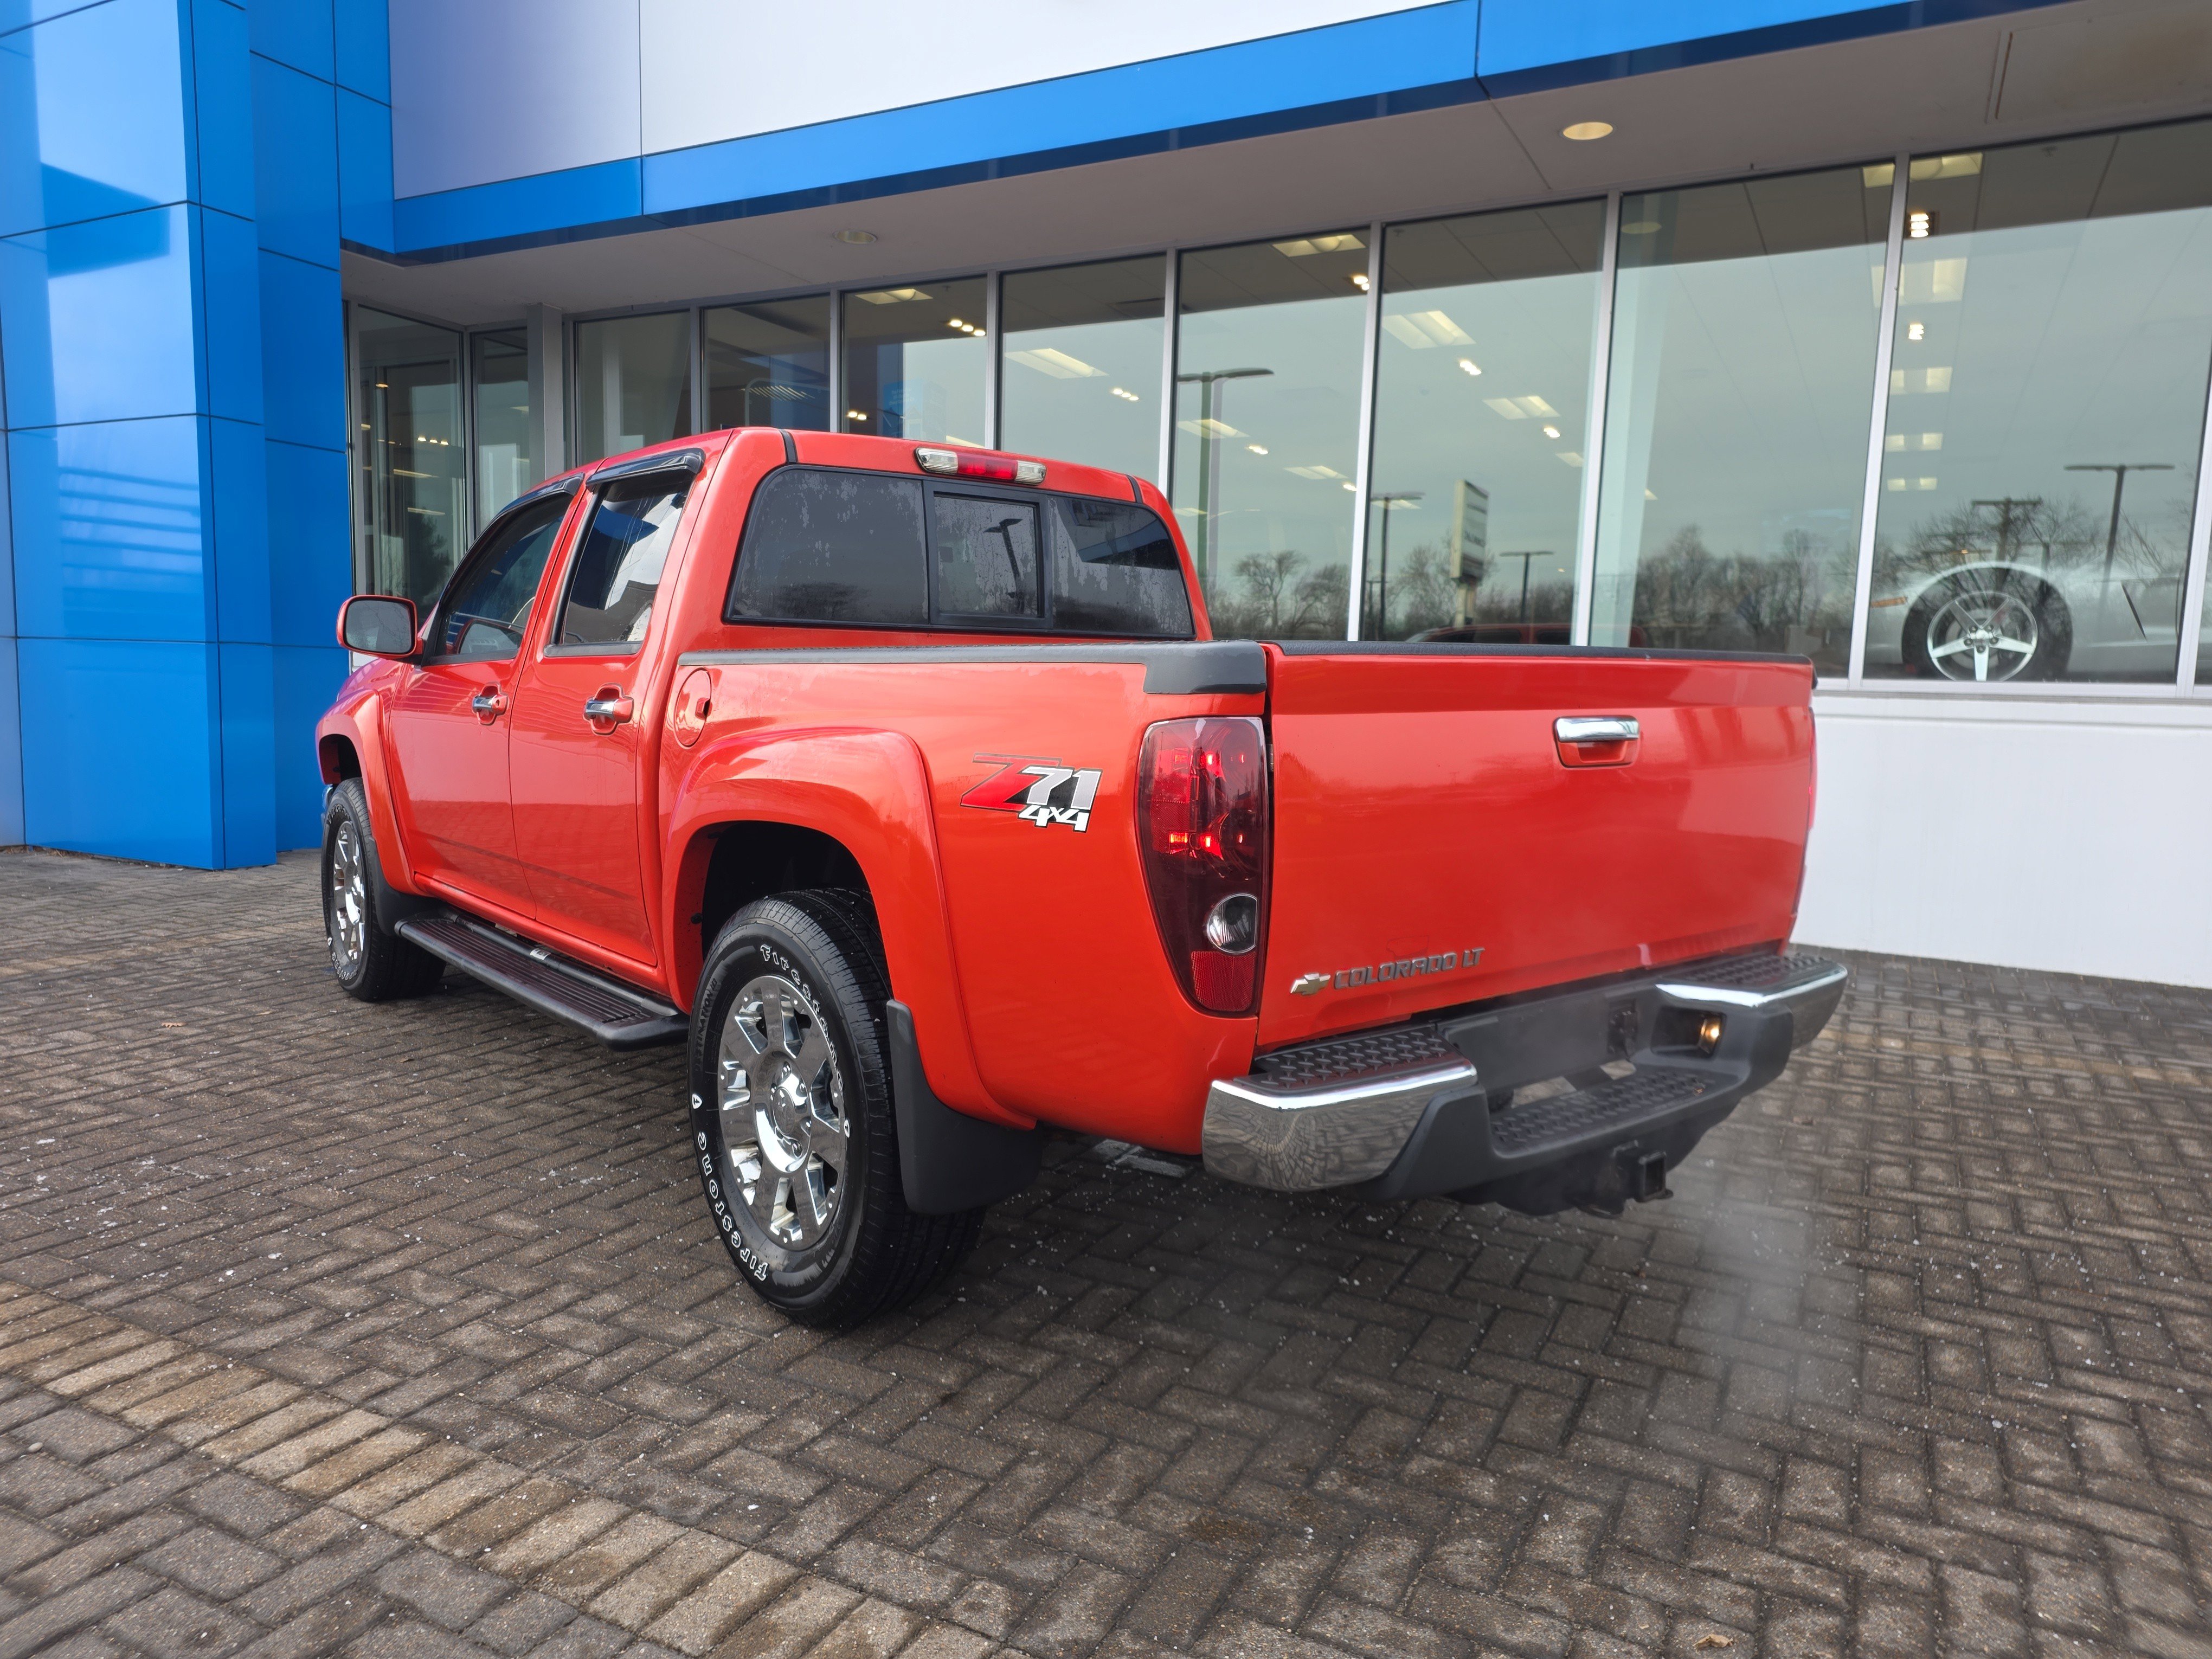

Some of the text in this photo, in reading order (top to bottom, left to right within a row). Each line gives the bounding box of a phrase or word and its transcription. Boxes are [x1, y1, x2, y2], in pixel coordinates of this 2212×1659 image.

[960, 753, 1103, 814] Z71
[1334, 947, 1486, 990] COLORADO LT
[697, 1131, 768, 1281] Firestone
